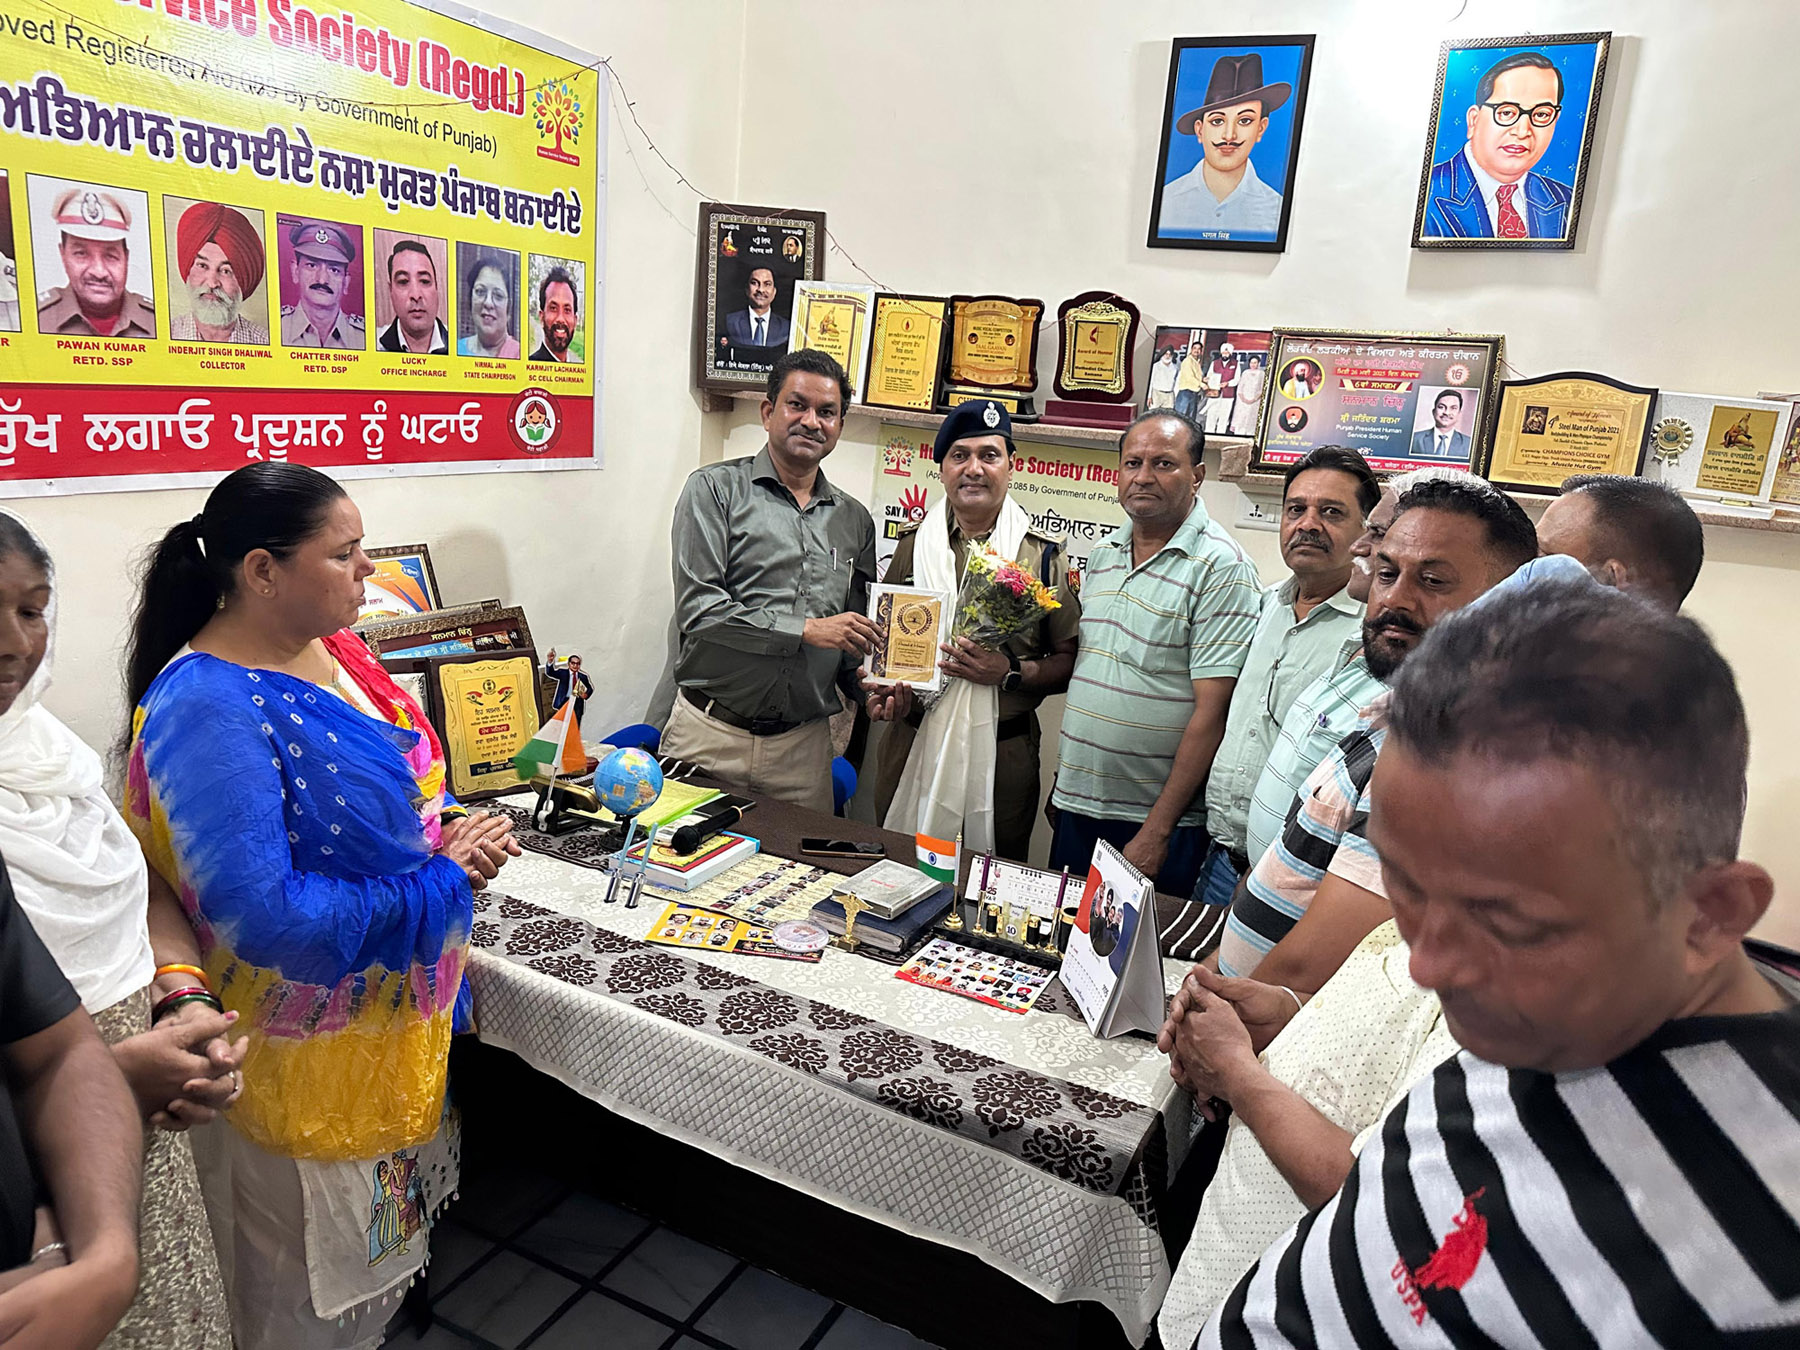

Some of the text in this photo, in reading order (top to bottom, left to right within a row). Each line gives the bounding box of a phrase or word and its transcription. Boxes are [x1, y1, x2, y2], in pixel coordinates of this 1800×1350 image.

[267, 0, 411, 86] Society
[418, 40, 525, 116] (Regd.)
[65, 24, 195, 79] Registered
[315, 91, 419, 136] Government
[423, 120, 439, 140] of
[442, 123, 497, 158] Punjab)
[180, 120, 314, 183] ਚਲਾਈਏ
[319, 151, 375, 196] ਨਸ਼ਾ
[379, 163, 437, 210] ਮੁਕਤ
[441, 167, 502, 220] ਪੰਜਾਬ
[503, 190, 582, 234] ਬਨਾਈਏ
[57, 340, 146, 352] PAWAN KUMAR
[168, 346, 273, 358] INDERJIT SINGH DHALIWAL
[290, 352, 359, 363] CHATTER SINGH
[1399, 347, 1416, 358] ਅਤੇ
[1418, 348, 1450, 359] ਕੀਰਤਨ
[1453, 350, 1480, 361] ਦੀਵਾਨ
[73, 356, 133, 366] RETD. SSP
[200, 361, 246, 371] COLLECTOR
[401, 357, 427, 366] LUCKY
[474, 361, 507, 370] NIRMAL JAIN
[304, 364, 348, 374] RETD. DSP
[381, 368, 447, 378] OFFICE INCHARGE
[526, 364, 553, 372] KARMJIT
[464, 371, 516, 381] STATE CHAIRPERSON
[554, 376, 584, 384] CHAIRMAN
[83, 399, 214, 452] ਲਗਾਓ
[231, 413, 347, 462] ਪ੍ਰਦੂਸ਼ਨ
[360, 399, 388, 460] ਨੂੰ
[400, 402, 482, 444] ਘਟਾਓ
[1335, 424, 1354, 432] Punjab
[1558, 423, 1571, 431] Steel
[1581, 424, 1588, 432] of
[1589, 424, 1607, 434] Punjab
[1607, 426, 1620, 434] 2021
[1542, 448, 1576, 456] CHAMPIONS
[1576, 450, 1596, 458] CHOICE
[1027, 456, 1084, 481] Society
[1086, 464, 1120, 486] (Reg
[1008, 481, 1120, 505] o.085 By Government of Punja
[884, 505, 901, 518] SAY
[430, 631, 456, 641] ਸਨਮਾਨ
[1007, 925, 1016, 936] 10
